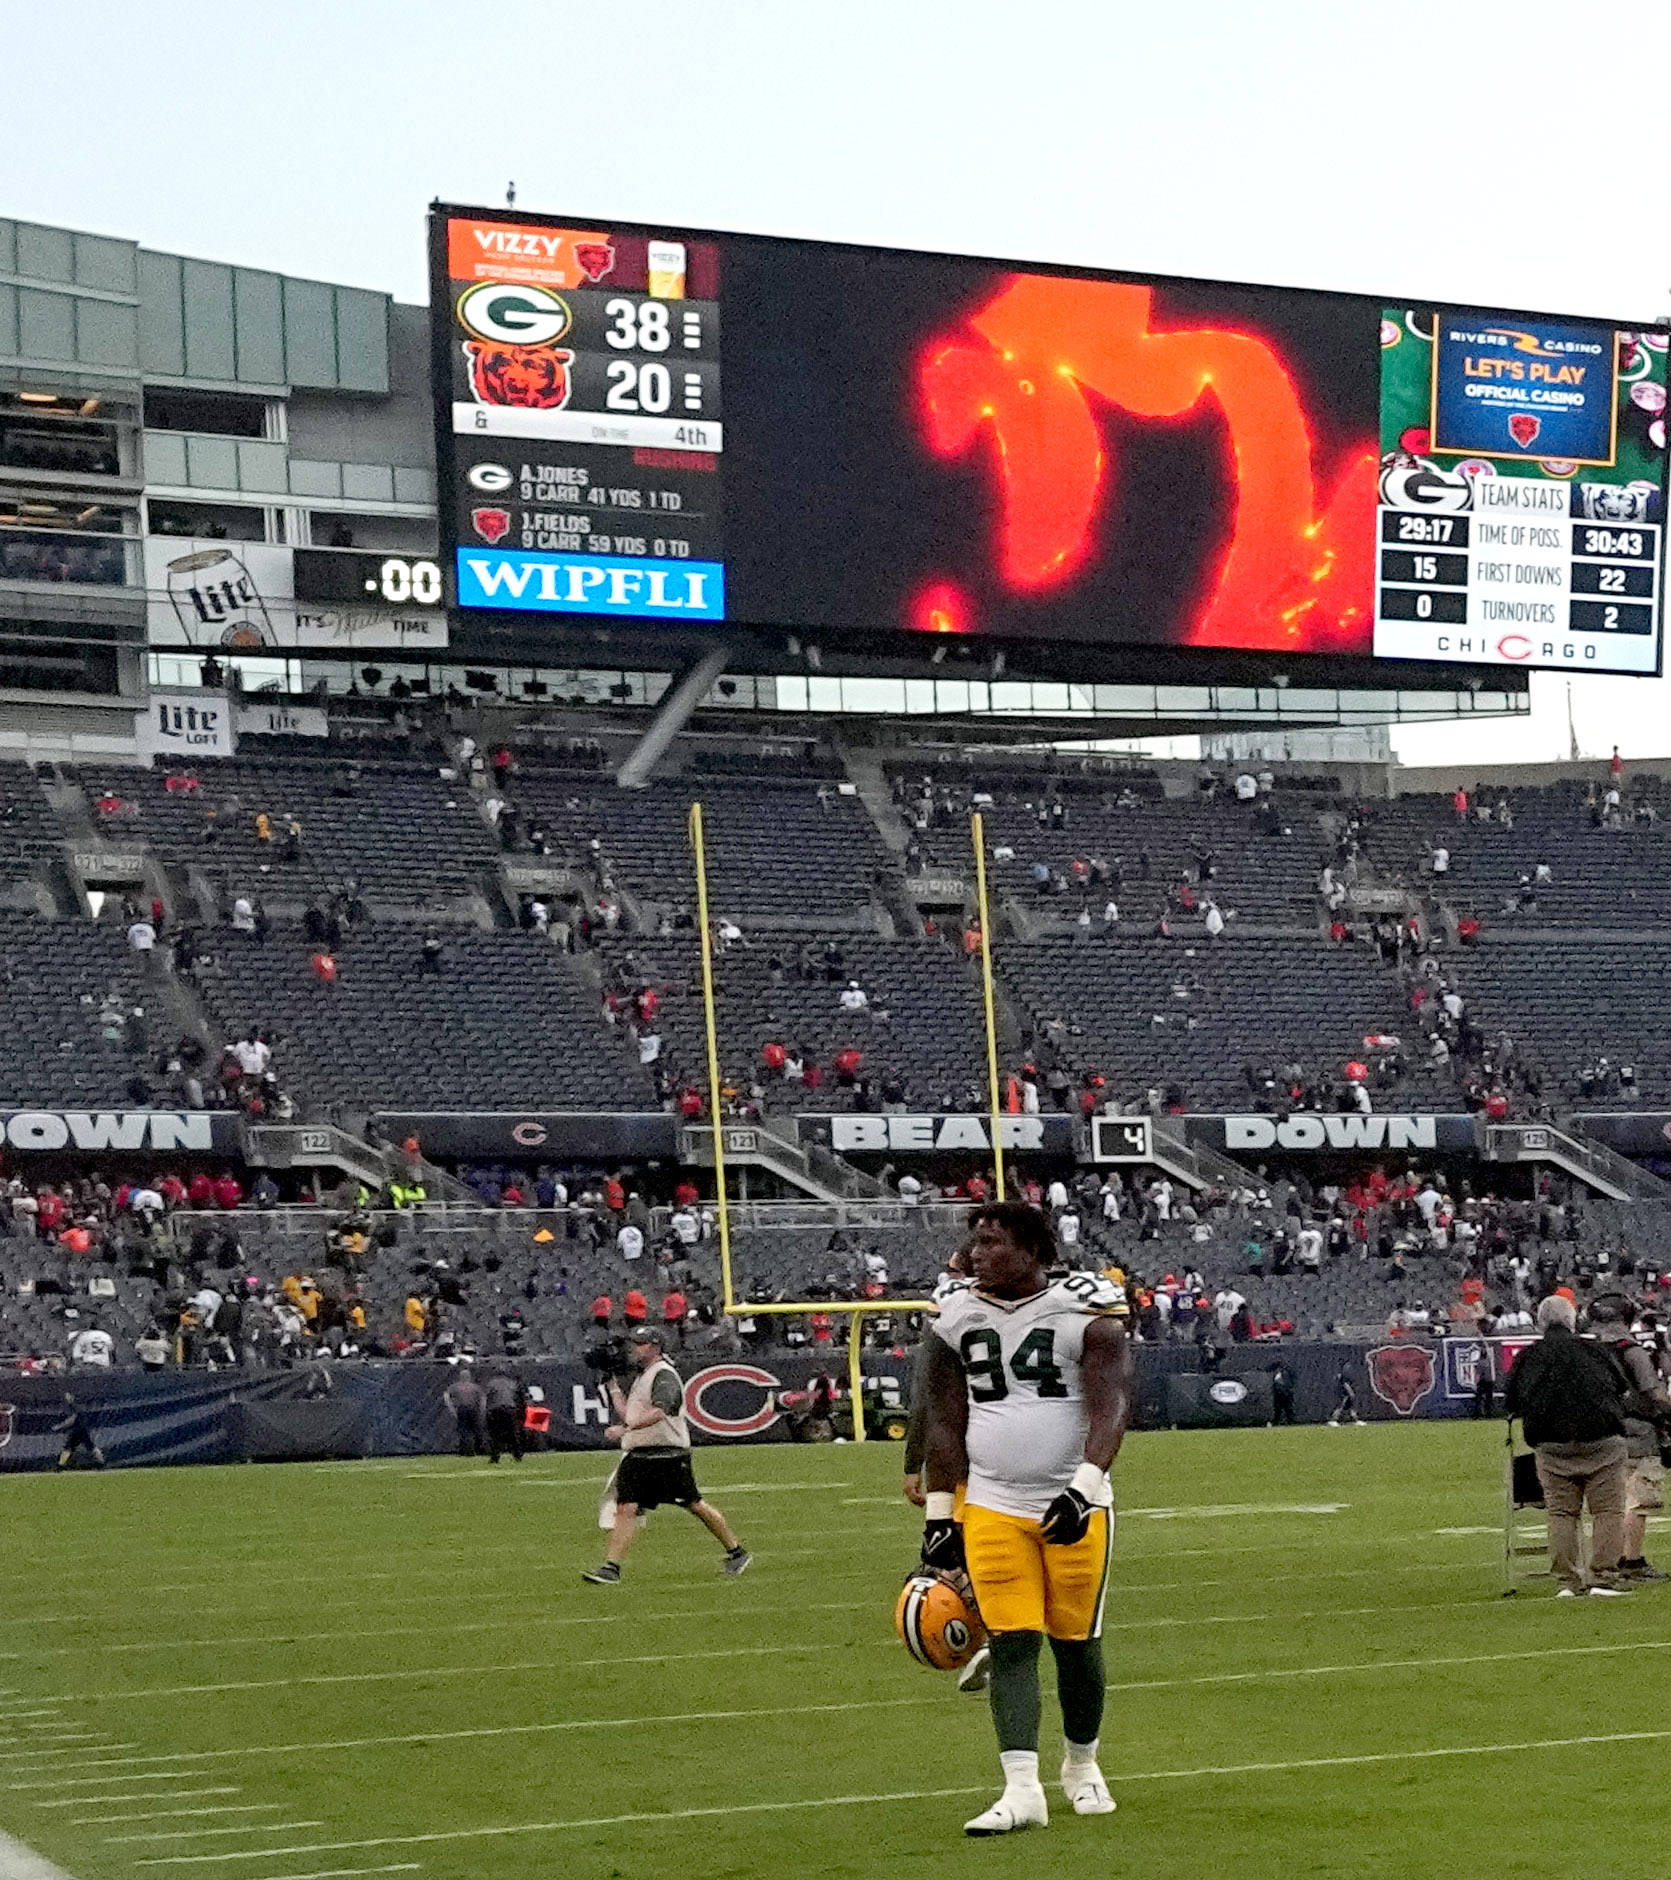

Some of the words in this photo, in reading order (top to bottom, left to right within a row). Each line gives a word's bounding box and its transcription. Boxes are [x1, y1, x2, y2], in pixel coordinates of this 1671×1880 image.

[473, 229, 563, 257] VIZZY
[605, 298, 670, 352] 38
[1450, 331, 1507, 346] RIVERS
[1544, 341, 1602, 354] CASINO
[1464, 357, 1524, 381] LET'S
[1530, 363, 1586, 385] PLAY
[606, 360, 671, 413] 20
[1465, 384, 1527, 401] OFFICIAL
[1531, 390, 1585, 406] CASINO
[475, 411, 488, 429] &
[675, 426, 707, 446] 4th
[520, 464, 589, 486] A.JONES
[520, 483, 532, 500] 9
[536, 484, 580, 502] CARR
[587, 489, 605, 505] 41
[609, 490, 641, 508] YDS
[661, 492, 681, 510] TD
[1481, 483, 1519, 507] TEAM
[1523, 487, 1564, 510] STATS
[522, 512, 591, 533] J.FIELDS
[1400, 517, 1453, 542] 29:17
[522, 531, 534, 549] 9
[537, 533, 580, 551] CARR
[589, 536, 610, 553] 59
[614, 537, 647, 555] YDS
[654, 538, 666, 556] 0
[668, 540, 689, 557] TD
[1479, 524, 1507, 544] TIME
[1511, 526, 1525, 545] OF
[1530, 527, 1563, 548] POSS.
[1585, 530, 1642, 555] 30:43
[1414, 557, 1437, 580] 15
[1478, 562, 1512, 582] FIRST
[1516, 565, 1562, 585] DOWNS
[1599, 569, 1625, 592] 22
[467, 559, 708, 609] WIPFLI
[187, 577, 252, 623] Lite
[1417, 595, 1432, 617] 0
[1482, 600, 1555, 623] TURNOVERS
[393, 619, 429, 634] TIME
[1604, 607, 1618, 629] 2
[160, 704, 217, 738] Lite
[187, 734, 218, 745] LOFT
[0, 1113, 212, 1149] OWN
[304, 1134, 327, 1148] 122
[831, 1117, 1044, 1150] BEAR
[1124, 1127, 1144, 1152] 4
[1224, 1117, 1437, 1149] DOWN
[959, 1327, 1069, 1403] 94
